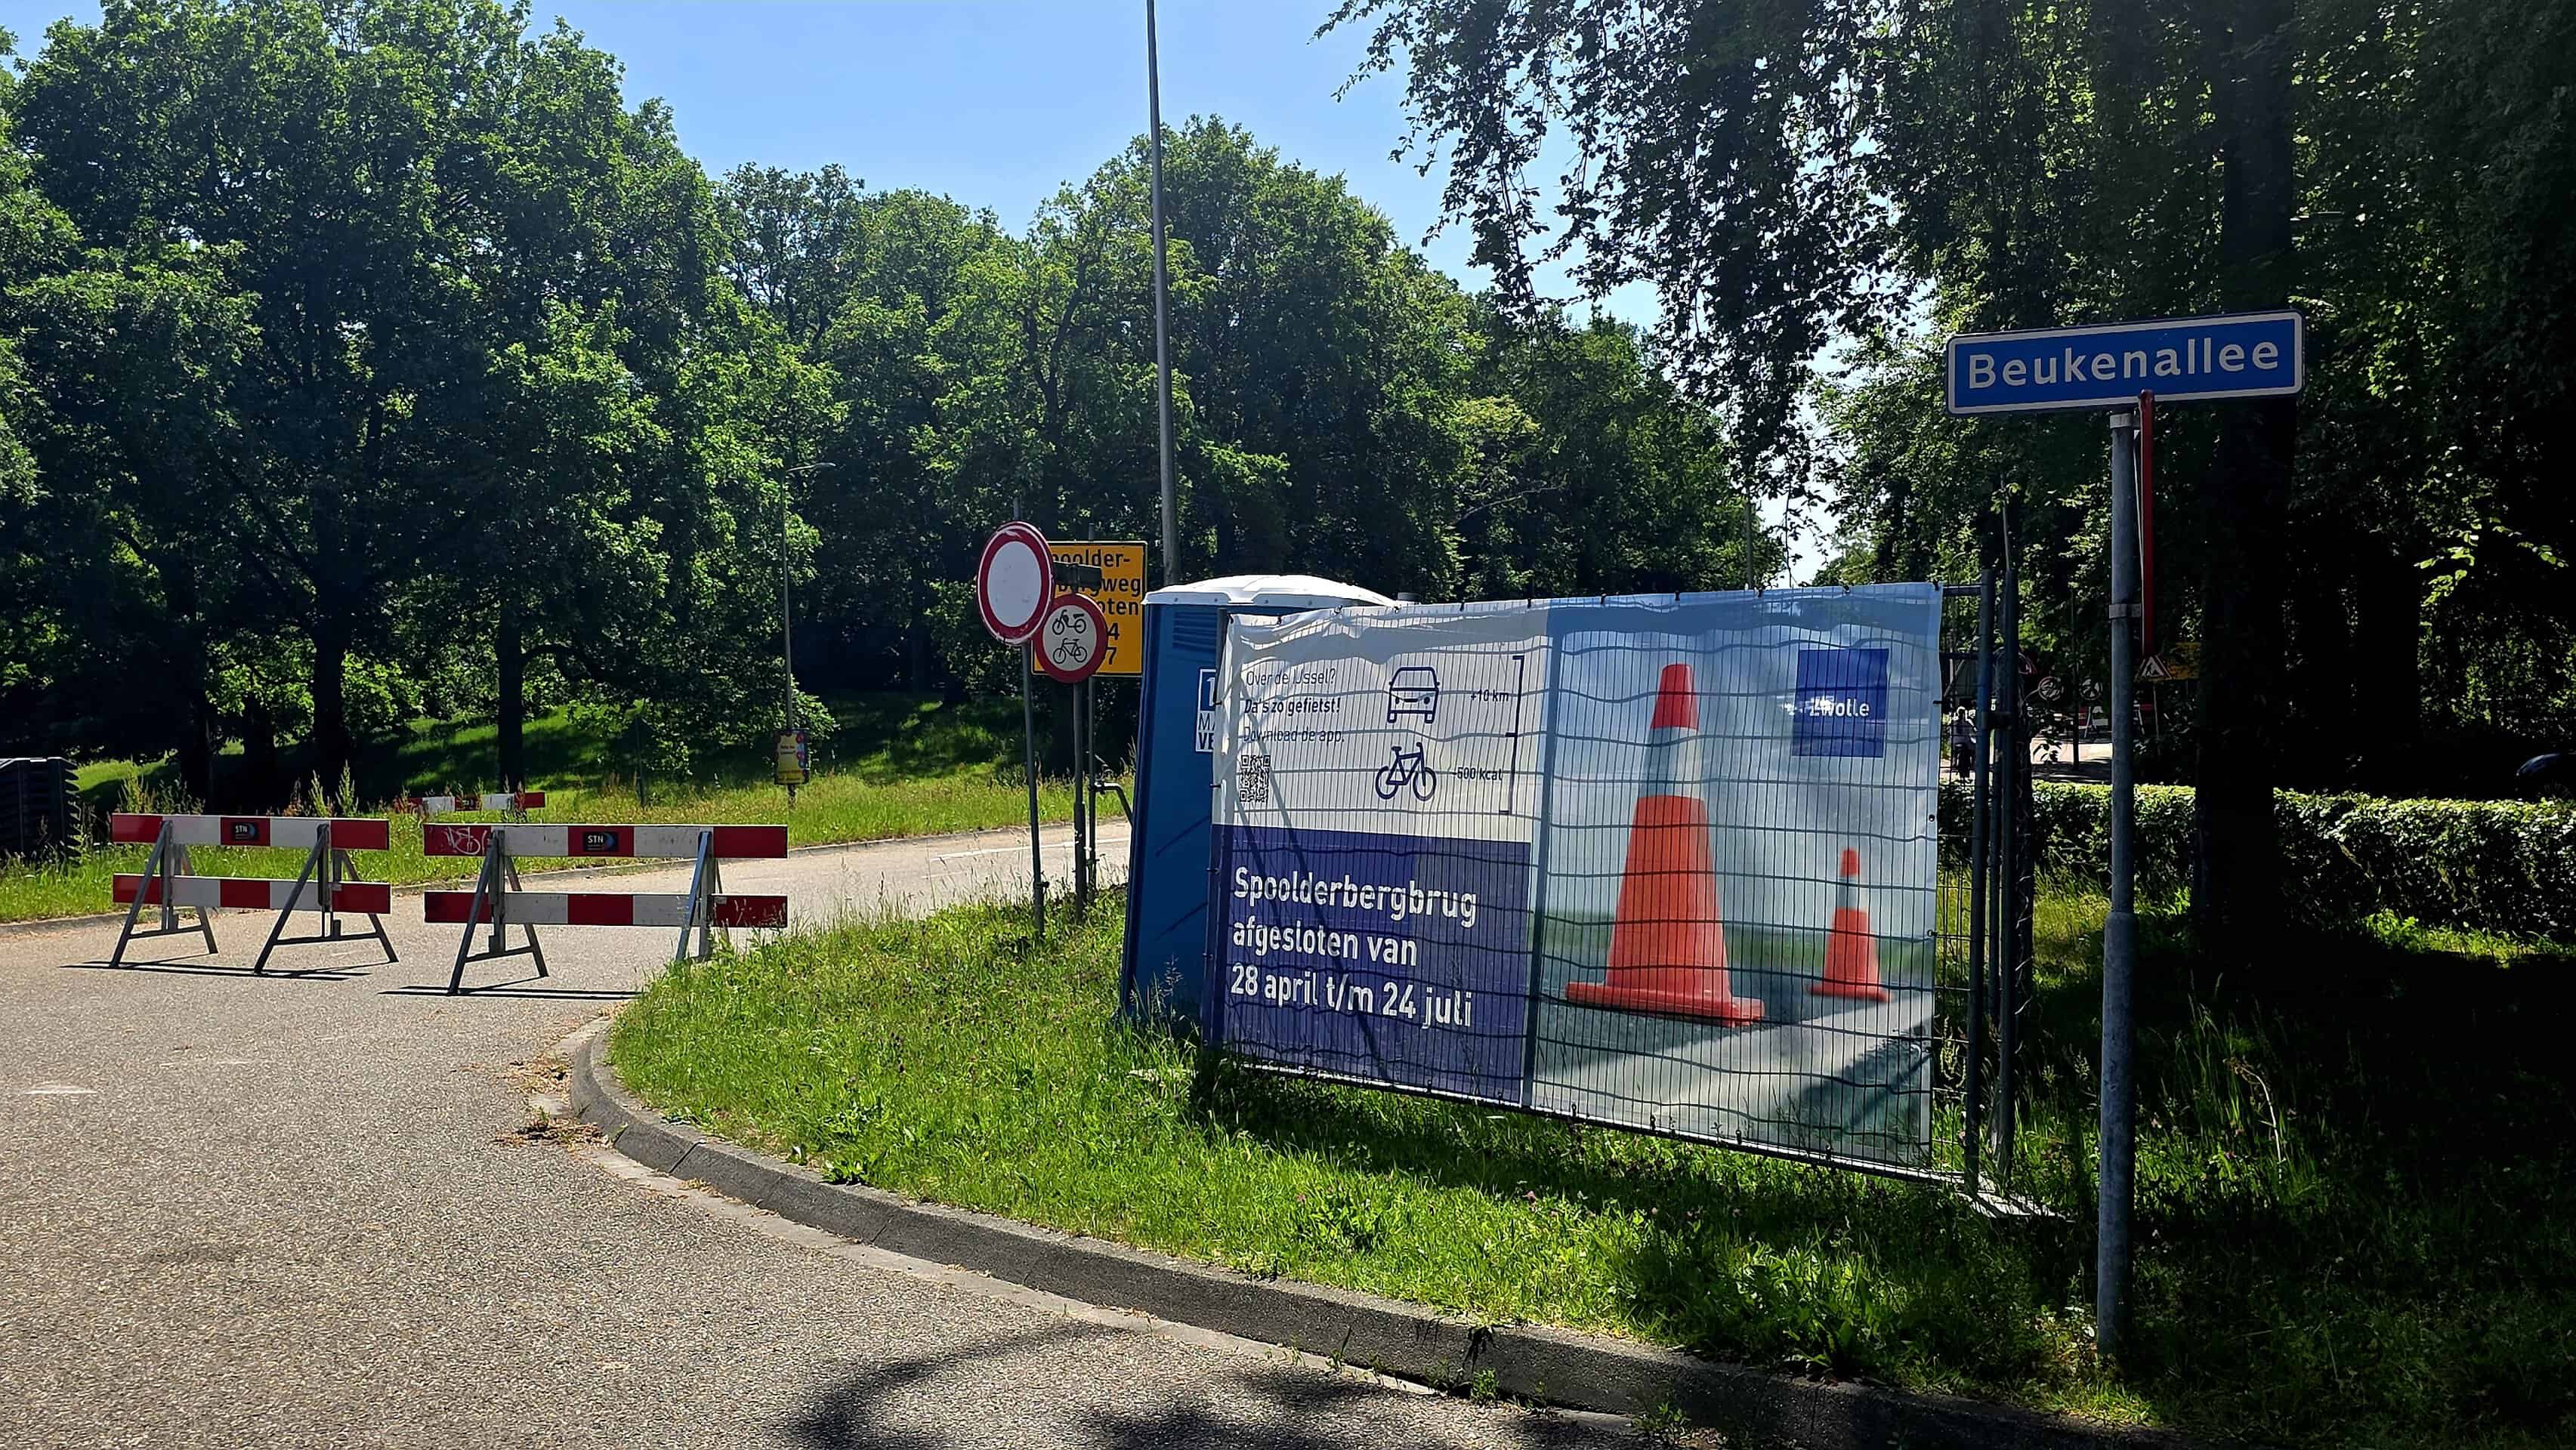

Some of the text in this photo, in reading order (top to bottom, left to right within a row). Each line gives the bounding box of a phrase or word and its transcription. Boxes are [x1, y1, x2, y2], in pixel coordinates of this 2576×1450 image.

[1968, 336, 2279, 389] Beukenallee
[1246, 671, 1272, 686] Over
[1274, 670, 1289, 684] de
[1492, 690, 1509, 702] km
[1271, 702, 1284, 713] zo
[1288, 698, 1341, 717] gefietst!
[1243, 726, 1345, 747] Download de app.
[1479, 767, 1503, 781] kcal
[1233, 866, 1477, 929] Spoolderbergbrug
[1233, 915, 1417, 967] afgesloten van
[1231, 963, 1472, 1030] 28 april t/m 24 juli
